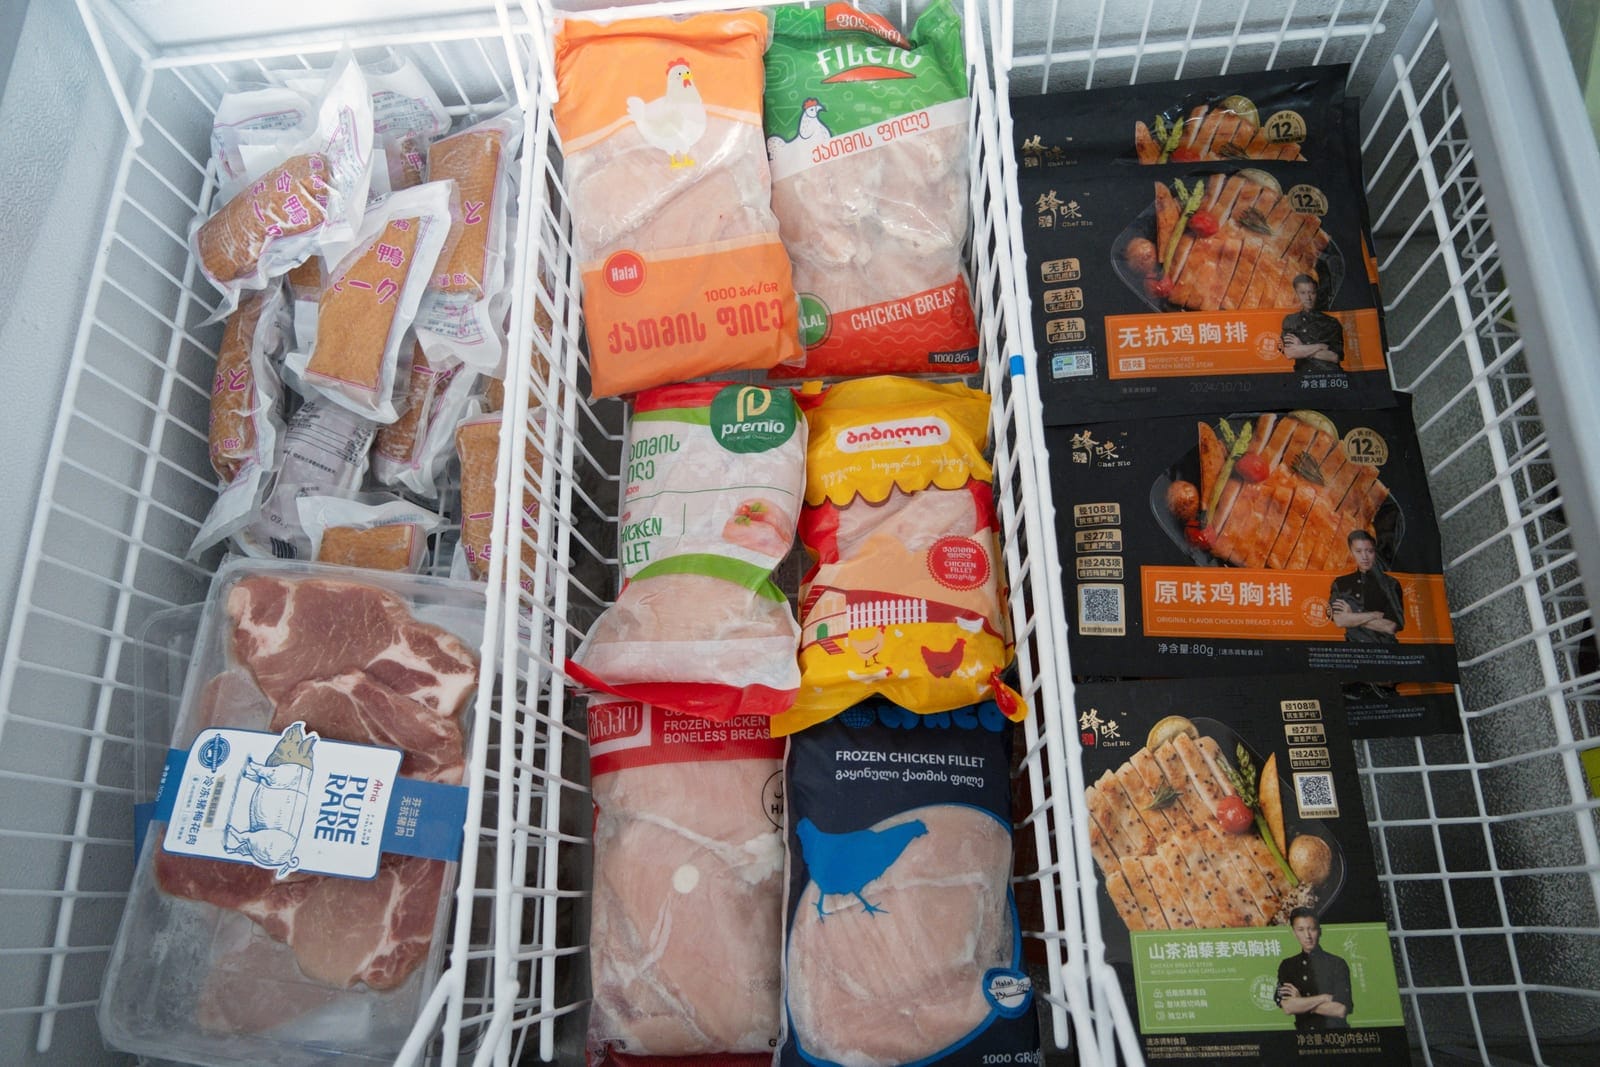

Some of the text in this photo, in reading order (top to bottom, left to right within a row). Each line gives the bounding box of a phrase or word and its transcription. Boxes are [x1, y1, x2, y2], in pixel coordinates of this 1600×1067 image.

[812, 111, 931, 164] ქათმის ფილე
[1272, 122, 1293, 138] 12
[1294, 194, 1315, 208] 12
[611, 265, 638, 282] Halal
[1048, 260, 1073, 273] 无抗
[704, 287, 737, 303] 1000
[1051, 290, 1076, 302] 无抗
[850, 287, 957, 331] CHICKEN BREAS
[607, 298, 785, 355] ქათმის ფილე
[797, 316, 825, 330] ALAL
[1053, 320, 1079, 332] 无抗
[1118, 321, 1249, 349] 无抗鸡胸排
[933, 353, 954, 363] 1000
[721, 420, 785, 439] premio
[1351, 438, 1375, 456] 12
[619, 517, 663, 545] HICKEN
[943, 560, 976, 568] CHICKEN
[1154, 580, 1293, 607] 原味鸡胸排
[1156, 616, 1188, 624] ORIGINAL
[1188, 617, 1214, 625] FLAVOR
[1158, 643, 1214, 657] 净含量:80g
[663, 716, 766, 732] FROZEN CHICKEN
[663, 728, 771, 744] BONELESS BREAS
[835, 750, 985, 769] FROZEN CHICKEN FILLET
[835, 766, 984, 789] გაყინული ქათმის ფილე
[369, 779, 384, 803] Atria
[313, 772, 348, 842] RARE
[334, 775, 369, 845] PURE
[1148, 939, 1281, 960] 山茶油藜麦鸡胸排
[995, 979, 1014, 987] Halal
[982, 1054, 1012, 1064] 1000
